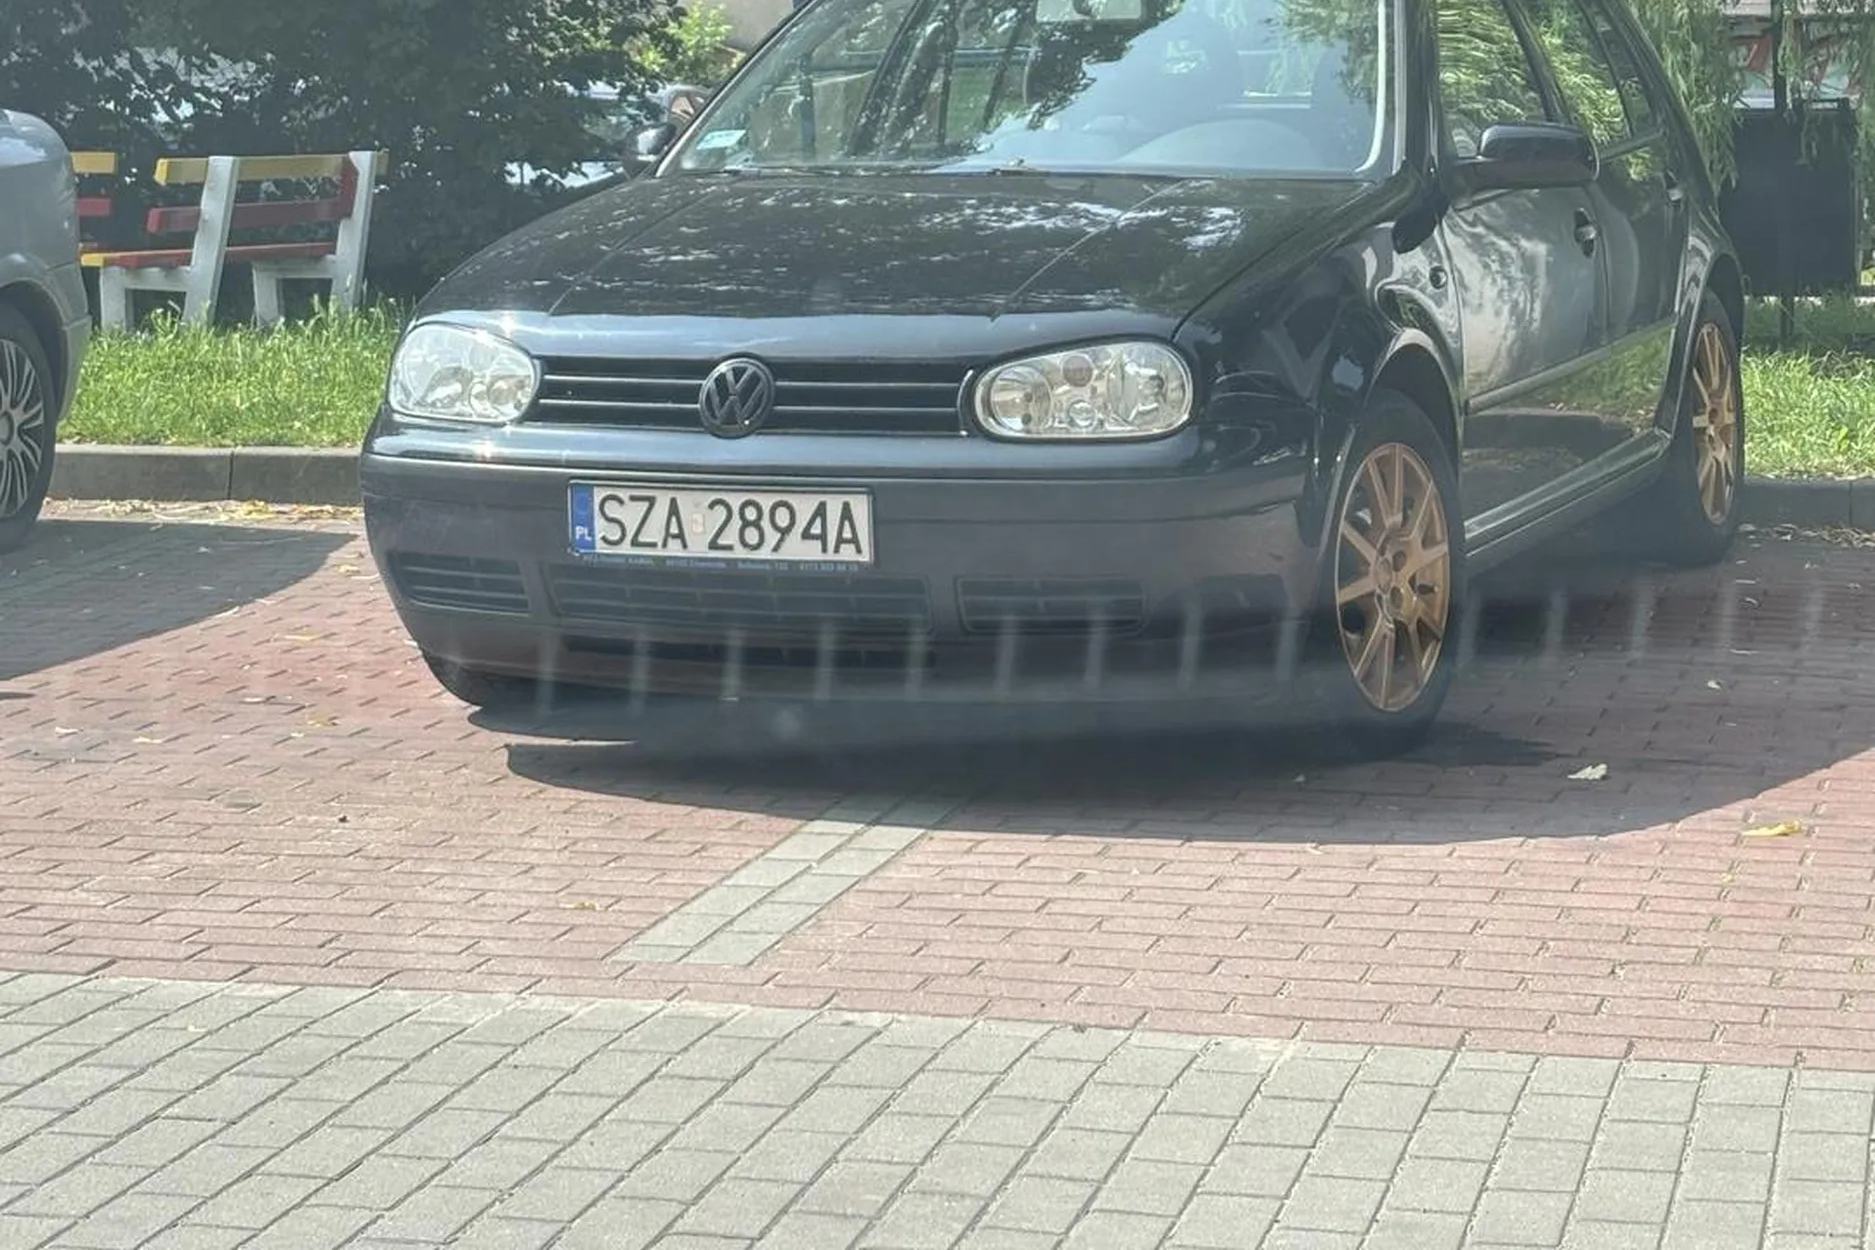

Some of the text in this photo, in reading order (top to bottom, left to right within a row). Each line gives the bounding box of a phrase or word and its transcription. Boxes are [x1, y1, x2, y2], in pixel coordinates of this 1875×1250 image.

[701, 359, 772, 433] VW
[575, 525, 592, 541] PL
[599, 494, 863, 554] SZA 2894A
